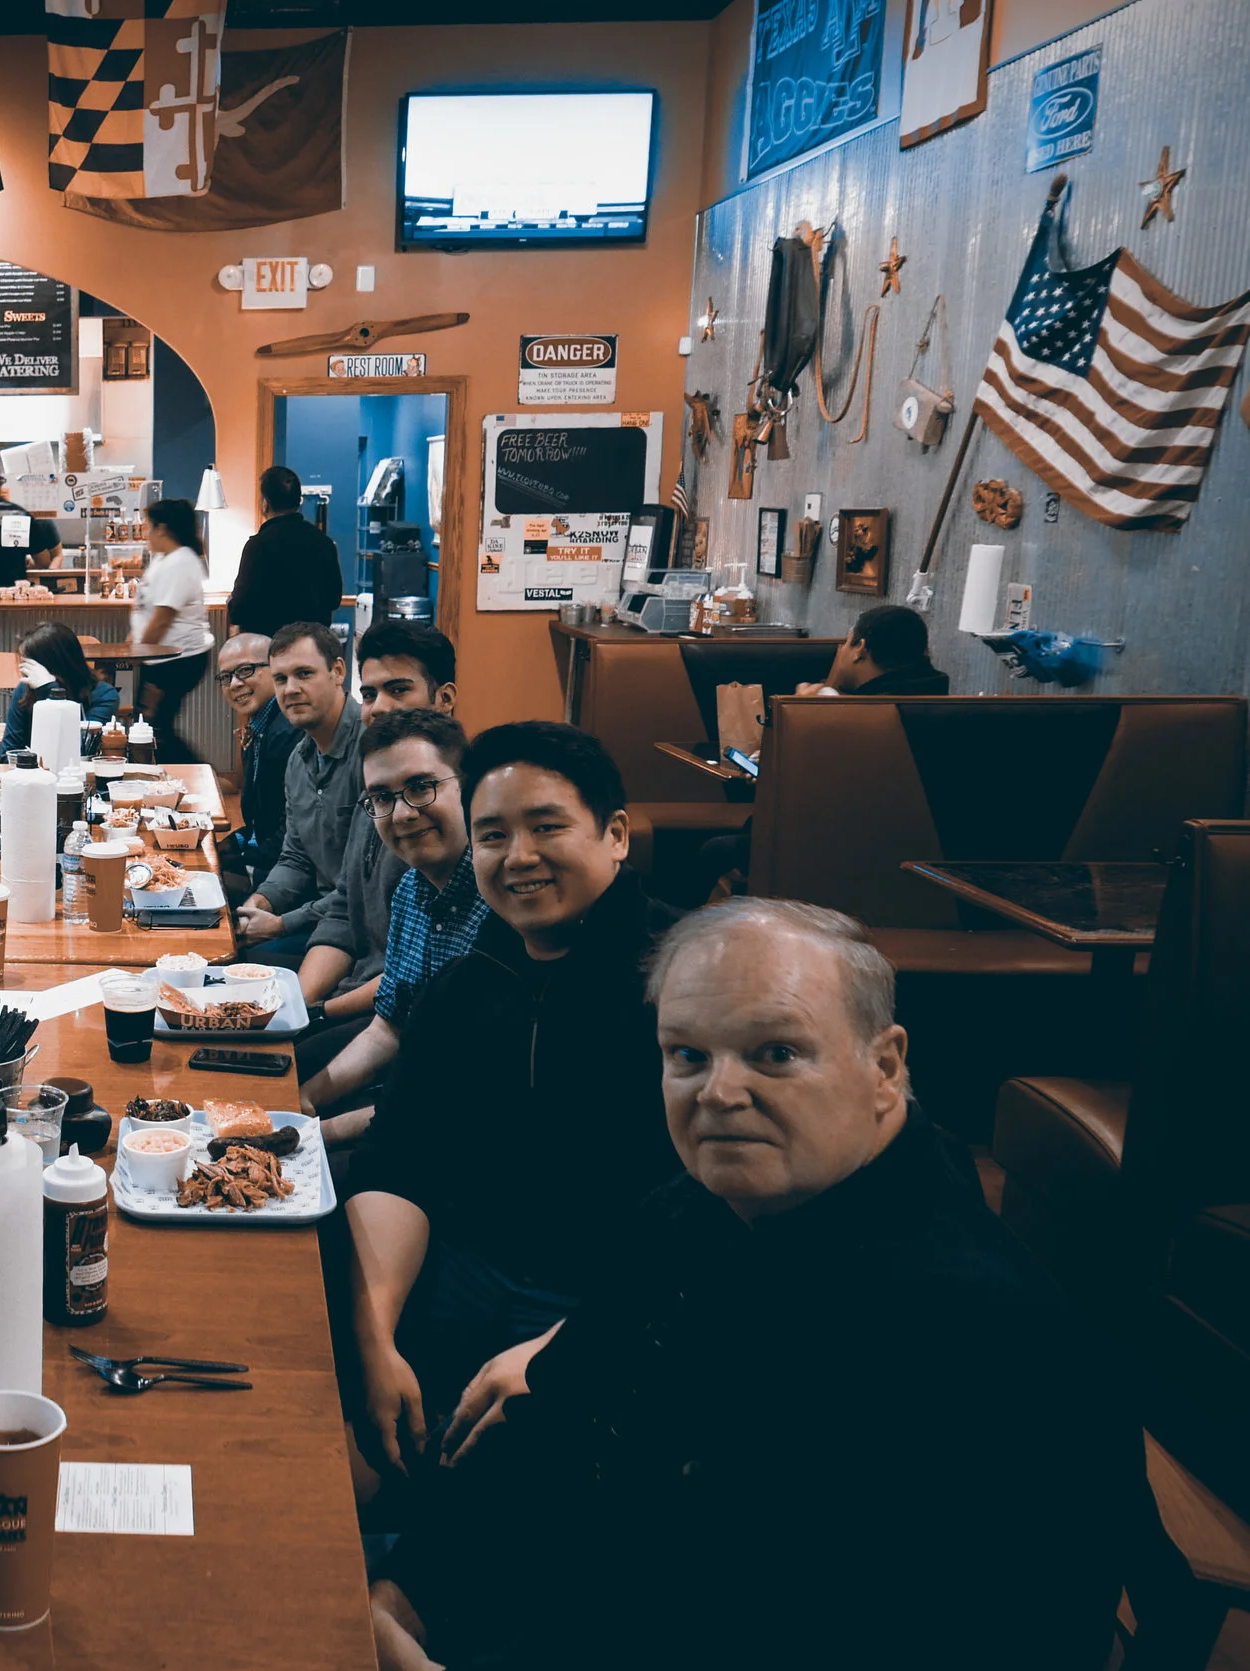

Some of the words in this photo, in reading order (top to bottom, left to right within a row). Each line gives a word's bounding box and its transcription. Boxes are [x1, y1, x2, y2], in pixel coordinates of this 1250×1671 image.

[750, 72, 875, 169] AGGIES
[1040, 94, 1081, 132] Ford
[1056, 130, 1091, 155] HERE
[255, 260, 298, 292] EXIT
[532, 344, 604, 361] DANGER
[347, 357, 372, 377] REST
[375, 357, 403, 377] ROOM
[501, 434, 531, 447] FREE
[534, 432, 568, 447] BEER
[526, 589, 561, 598] VESTAL
[180, 1014, 251, 1029] URBAN
